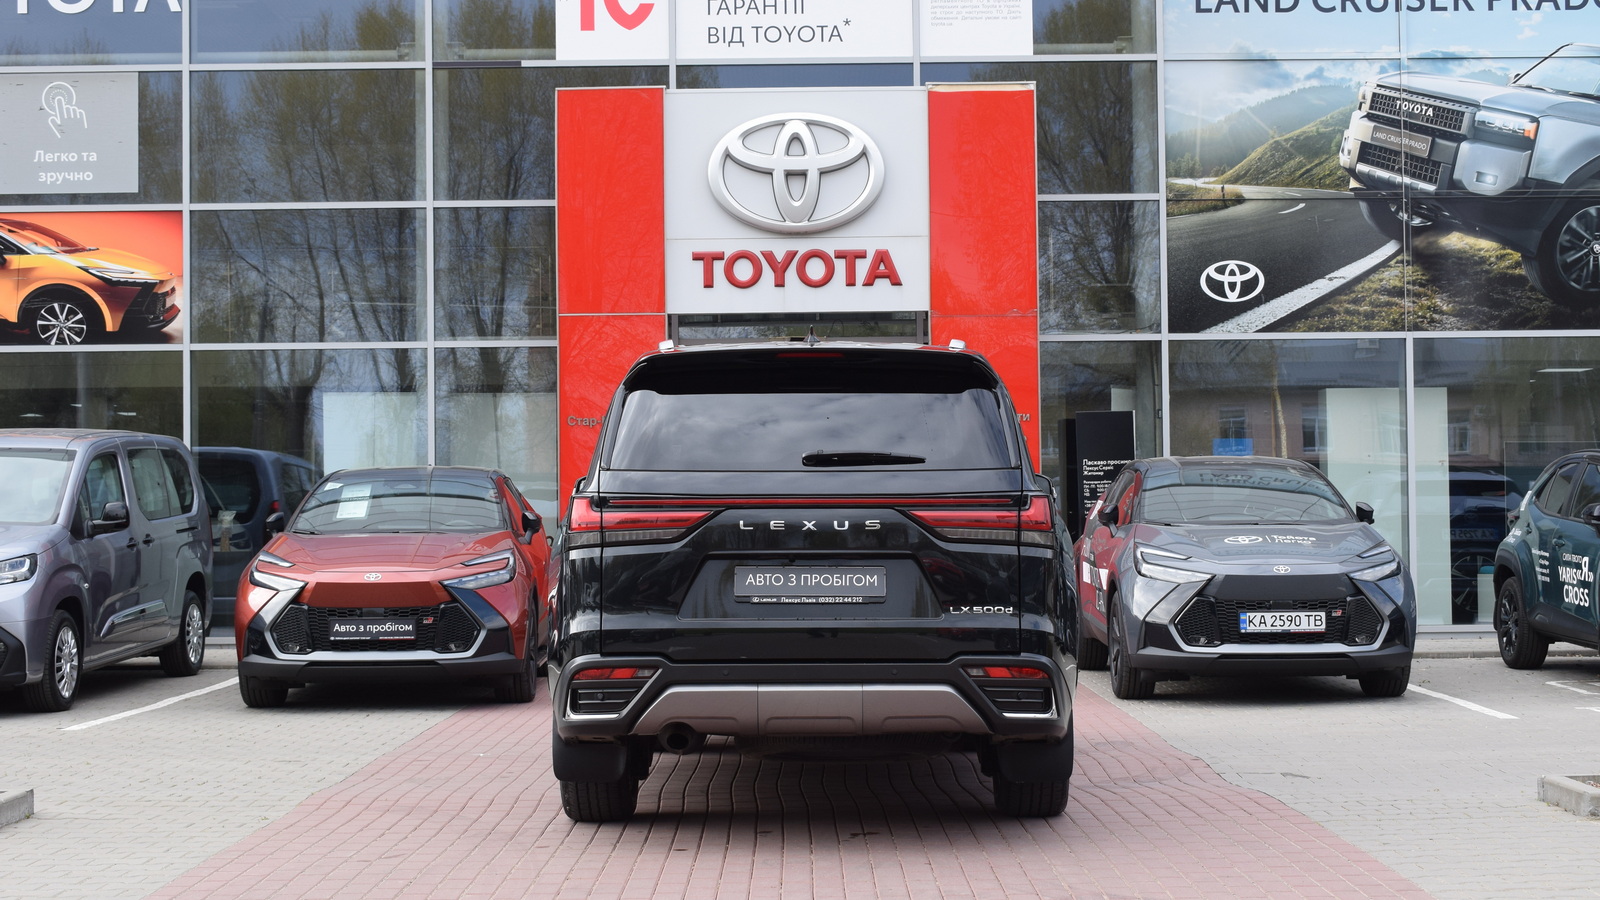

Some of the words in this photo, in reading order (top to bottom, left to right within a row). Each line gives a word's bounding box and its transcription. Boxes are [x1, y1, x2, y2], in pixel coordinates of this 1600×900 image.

[707, 26, 745, 48] ВІД
[1396, 100, 1434, 117] TOYOTA
[1373, 131, 1387, 140] LAND
[1387, 134, 1409, 145] CRUISER
[1409, 139, 1427, 150] PRADO
[33, 150, 78, 162] Легко
[81, 152, 97, 162] та
[38, 171, 93, 184] зручно
[691, 248, 903, 289] TOYOTA
[739, 519, 881, 531] LEXUS
[745, 573, 784, 586] АВТО
[801, 574, 878, 587] ПРОБІГОМ
[1557, 565, 1577, 585] YARIS
[818, 596, 834, 604] (032)
[1563, 584, 1590, 608] CROSS
[333, 623, 356, 632] Авто
[366, 622, 413, 634] пробігом
[1270, 614, 1302, 628] 2590
